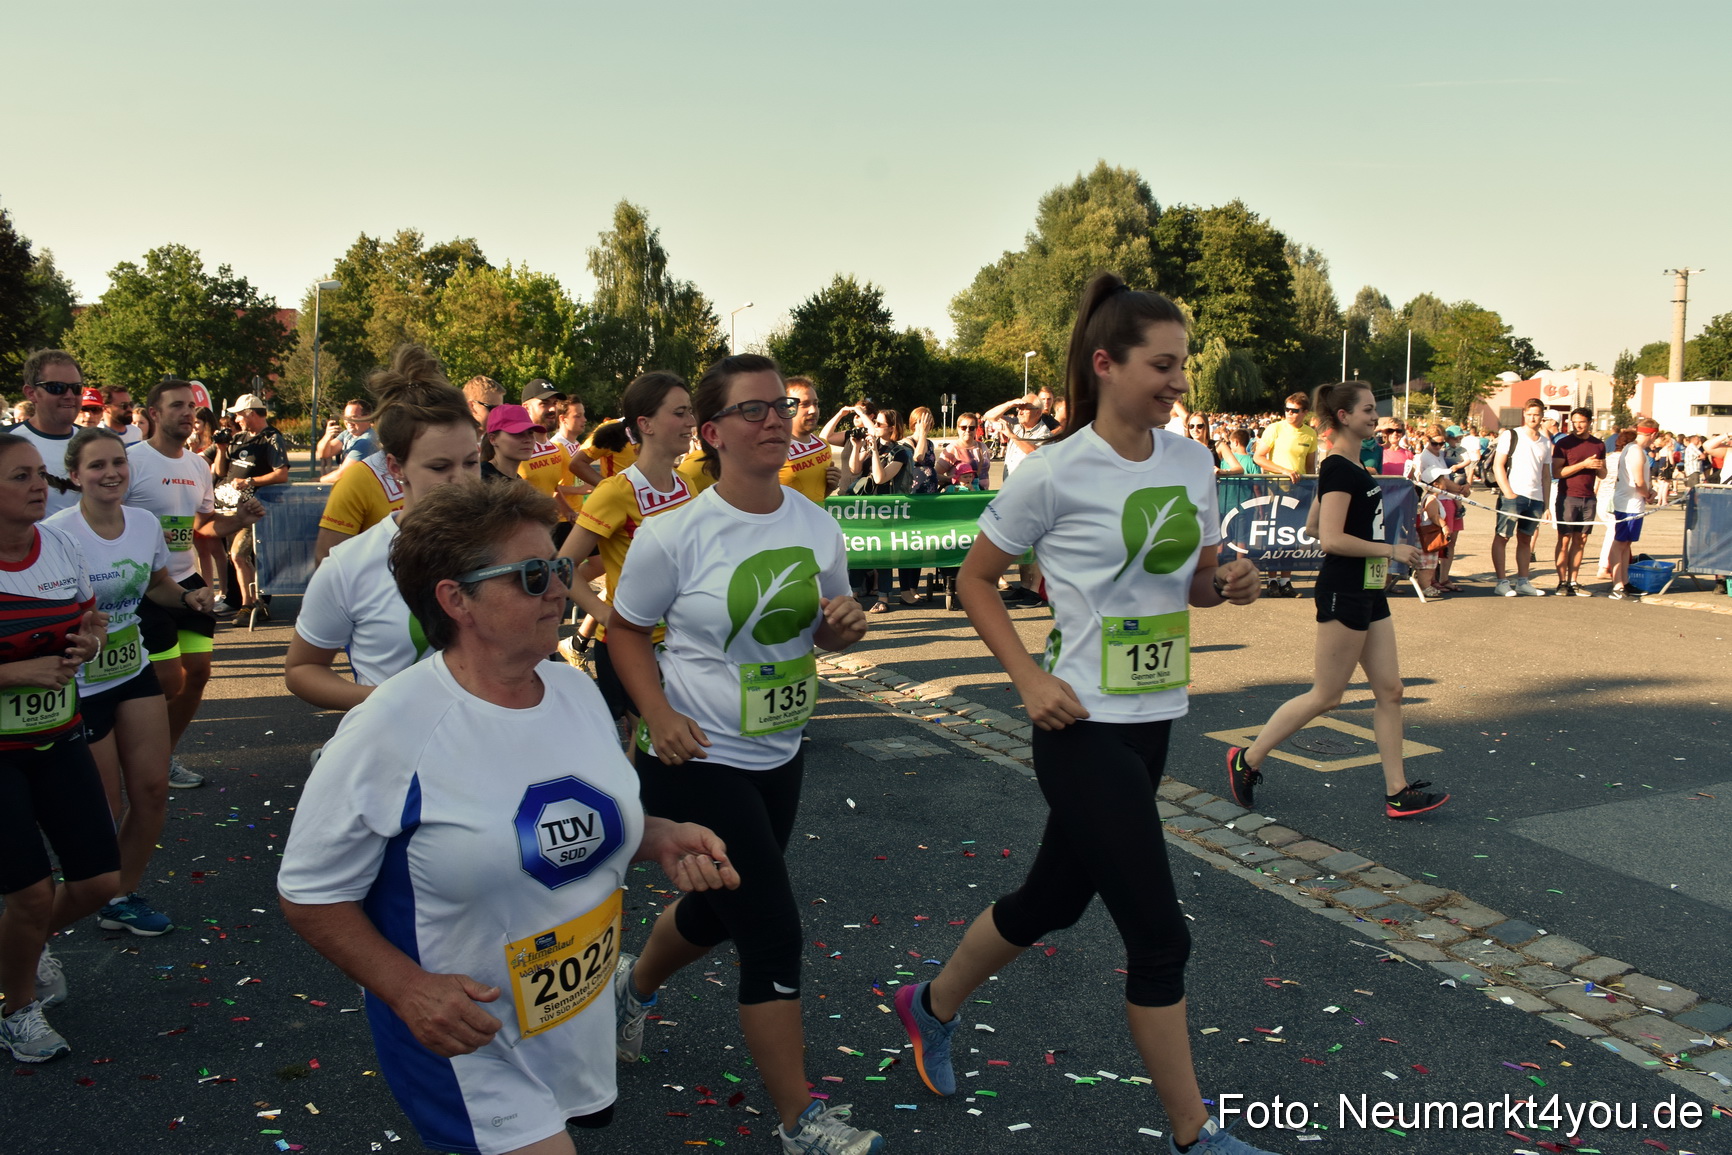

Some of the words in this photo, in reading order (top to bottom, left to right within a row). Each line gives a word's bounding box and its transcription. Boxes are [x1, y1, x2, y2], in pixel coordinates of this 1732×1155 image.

[529, 459, 549, 470] MAX
[791, 459, 815, 472] MAX
[816, 451, 832, 464] BÖG
[828, 500, 911, 520] ndheit
[843, 533, 881, 552] ten
[1249, 520, 1321, 546] Fisc
[89, 571, 121, 582] BERATA
[98, 643, 137, 668] 1038
[1126, 641, 1174, 672] 137
[9, 687, 66, 717] 1901
[764, 681, 807, 714] 135
[541, 813, 594, 846] TÜV
[560, 847, 587, 863] SÜD
[527, 935, 575, 962] firmenlauf
[531, 926, 614, 1007] 2022
[543, 982, 591, 1014] Siemantel
[539, 1012, 555, 1024] TÜV
[556, 1005, 571, 1017] SÜD
